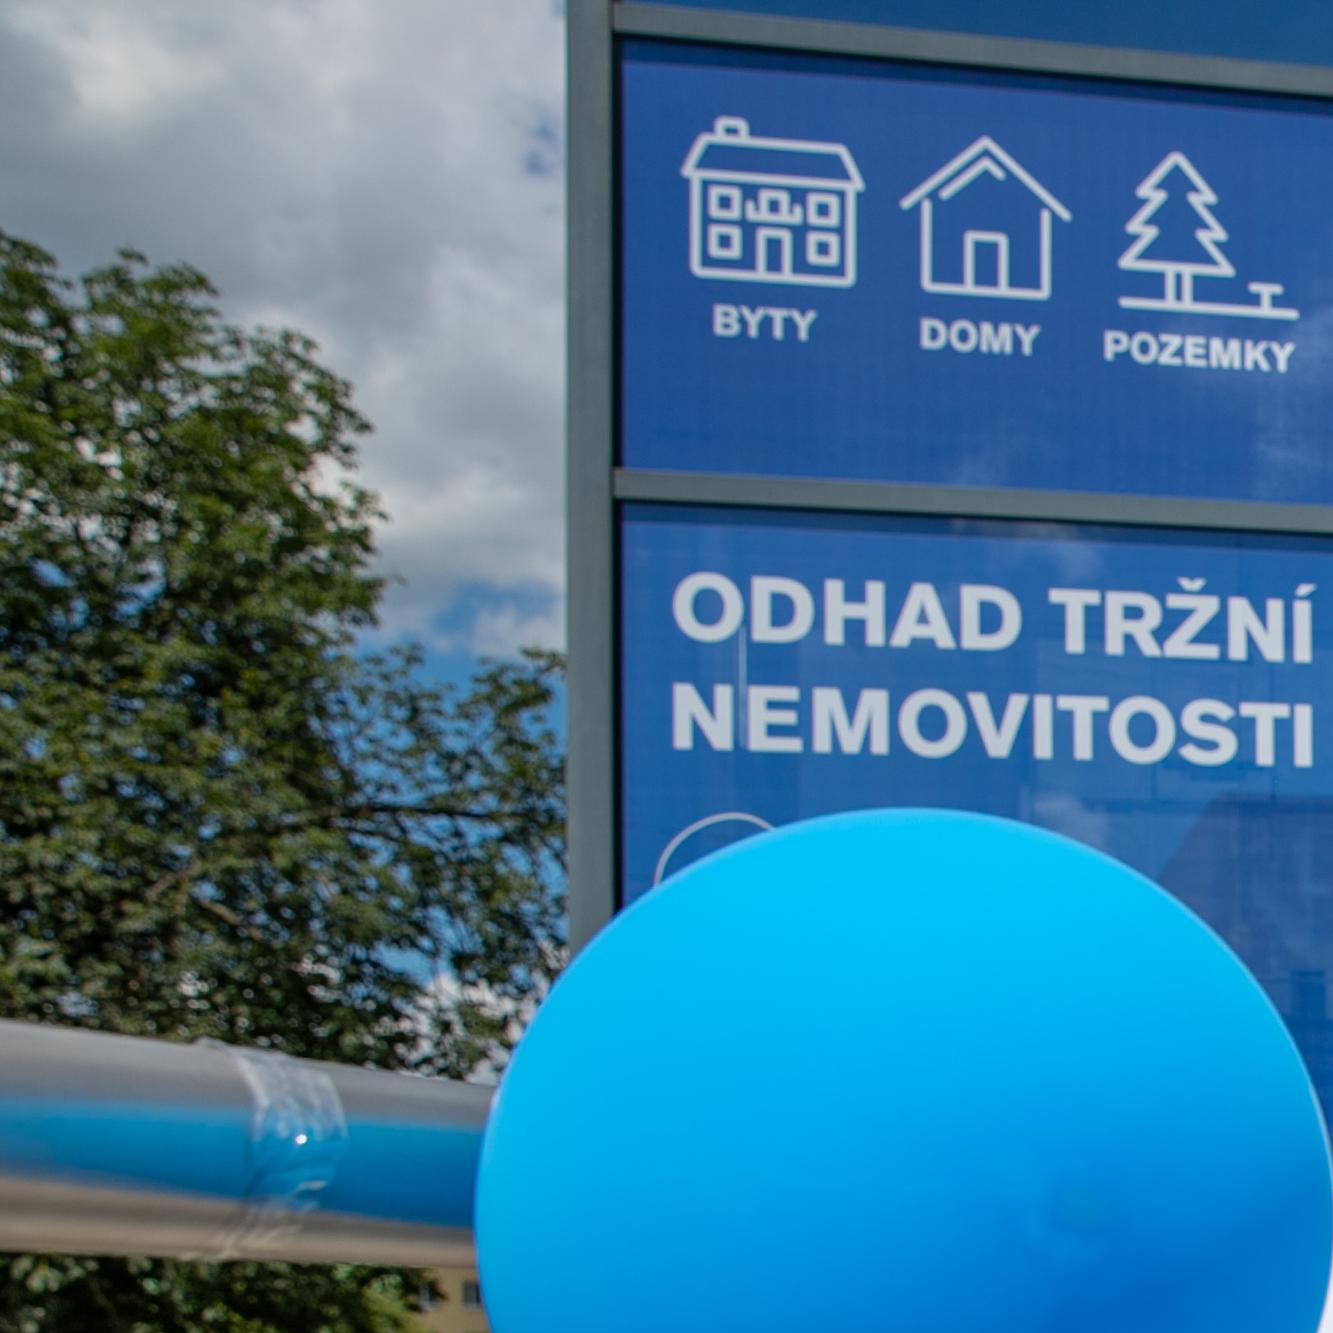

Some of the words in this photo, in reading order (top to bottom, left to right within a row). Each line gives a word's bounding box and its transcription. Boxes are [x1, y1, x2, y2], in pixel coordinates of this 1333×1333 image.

[712, 303, 817, 341] BYTY
[919, 317, 1040, 356] DOMY
[1103, 330, 1296, 374] POZEMKY
[672, 571, 1022, 651] ODHAD
[1047, 577, 1316, 664] TRŽNÍ
[672, 682, 1313, 767] NEMOVITOSTI
